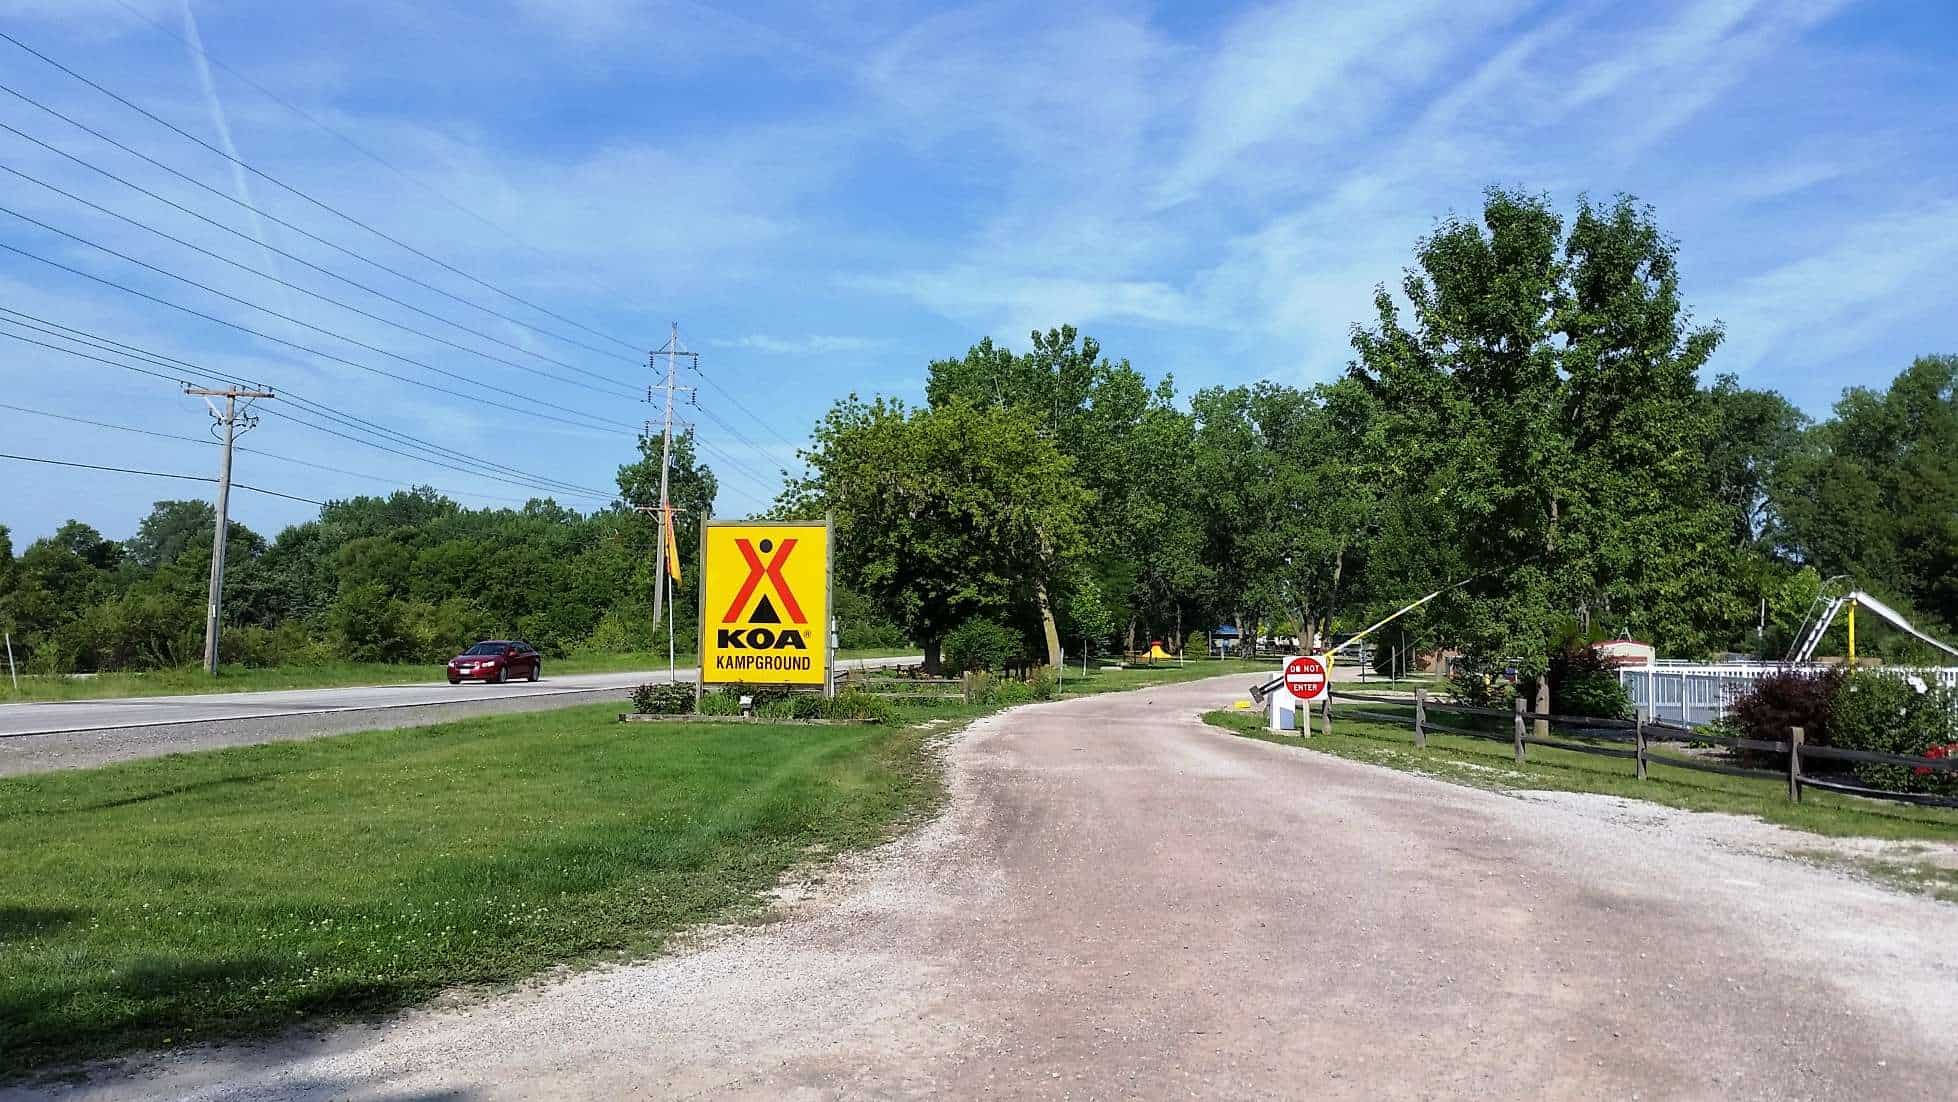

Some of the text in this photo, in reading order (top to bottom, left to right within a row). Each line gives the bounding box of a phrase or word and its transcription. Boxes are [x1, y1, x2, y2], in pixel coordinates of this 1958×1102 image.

[716, 655, 811, 671] KAMPGROUND
[1290, 664, 1320, 673] DO NOT
[1293, 683, 1318, 692] ENTER
